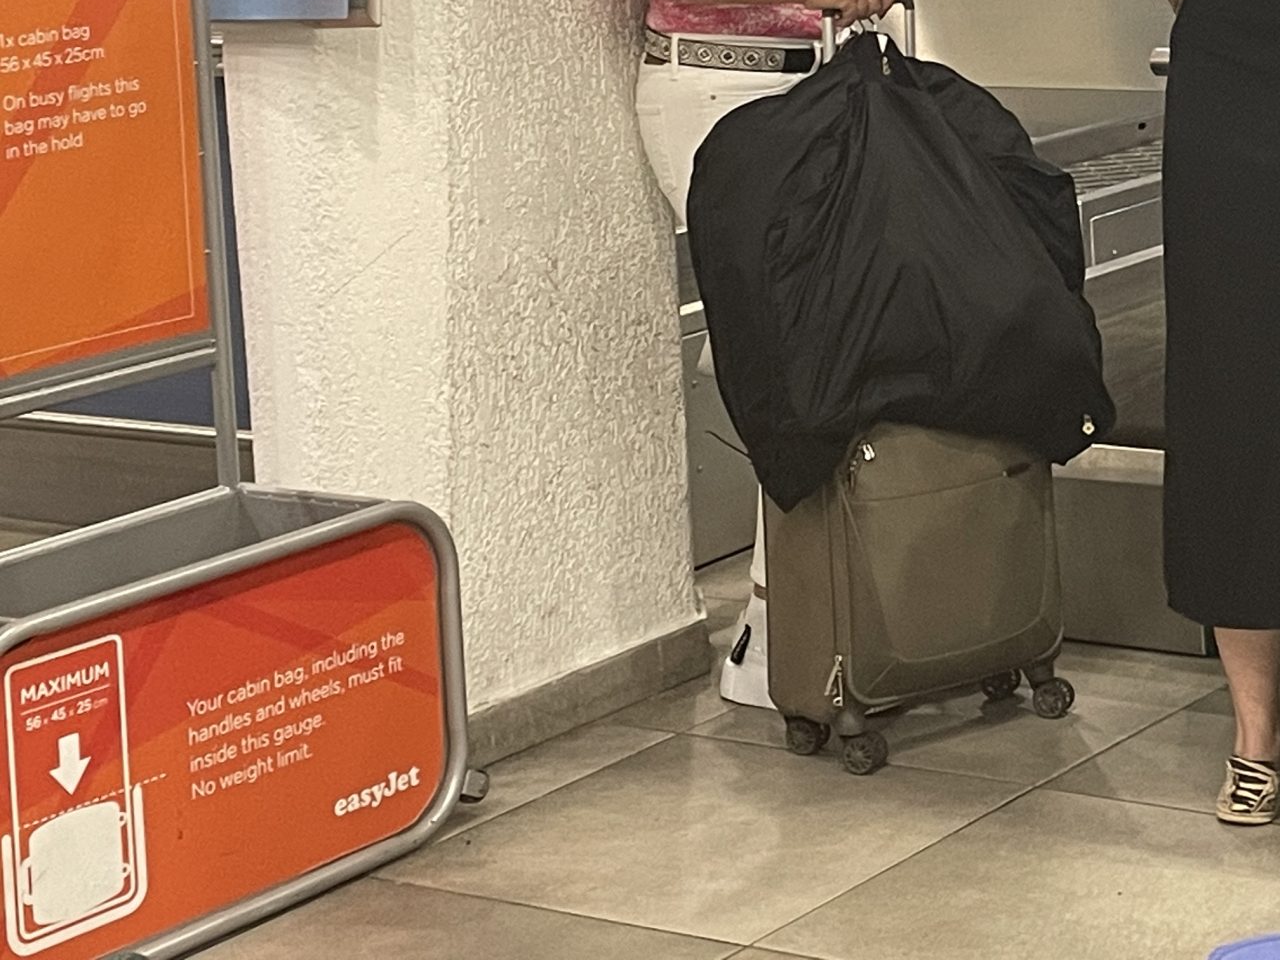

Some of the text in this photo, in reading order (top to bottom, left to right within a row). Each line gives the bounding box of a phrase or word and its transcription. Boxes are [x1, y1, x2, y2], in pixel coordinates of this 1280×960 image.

[18, 27, 59, 46] cabin
[62, 25, 90, 41] bag
[0, 45, 104, 73] 56 x 45 x 25cm
[3, 77, 140, 112] On busy flights this
[4, 100, 146, 136] bag may have to go
[6, 131, 83, 159] in the hold
[20, 661, 110, 705] MAXIMUM
[186, 631, 405, 718] Your cabin bag, including the
[25, 715, 42, 732] 56
[50, 706, 67, 721] 45
[188, 655, 404, 746] handles and wheels, must fit
[189, 713, 326, 773] inside this gauge.
[190, 742, 314, 802] No weight limit.
[332, 765, 420, 817] easyJet
